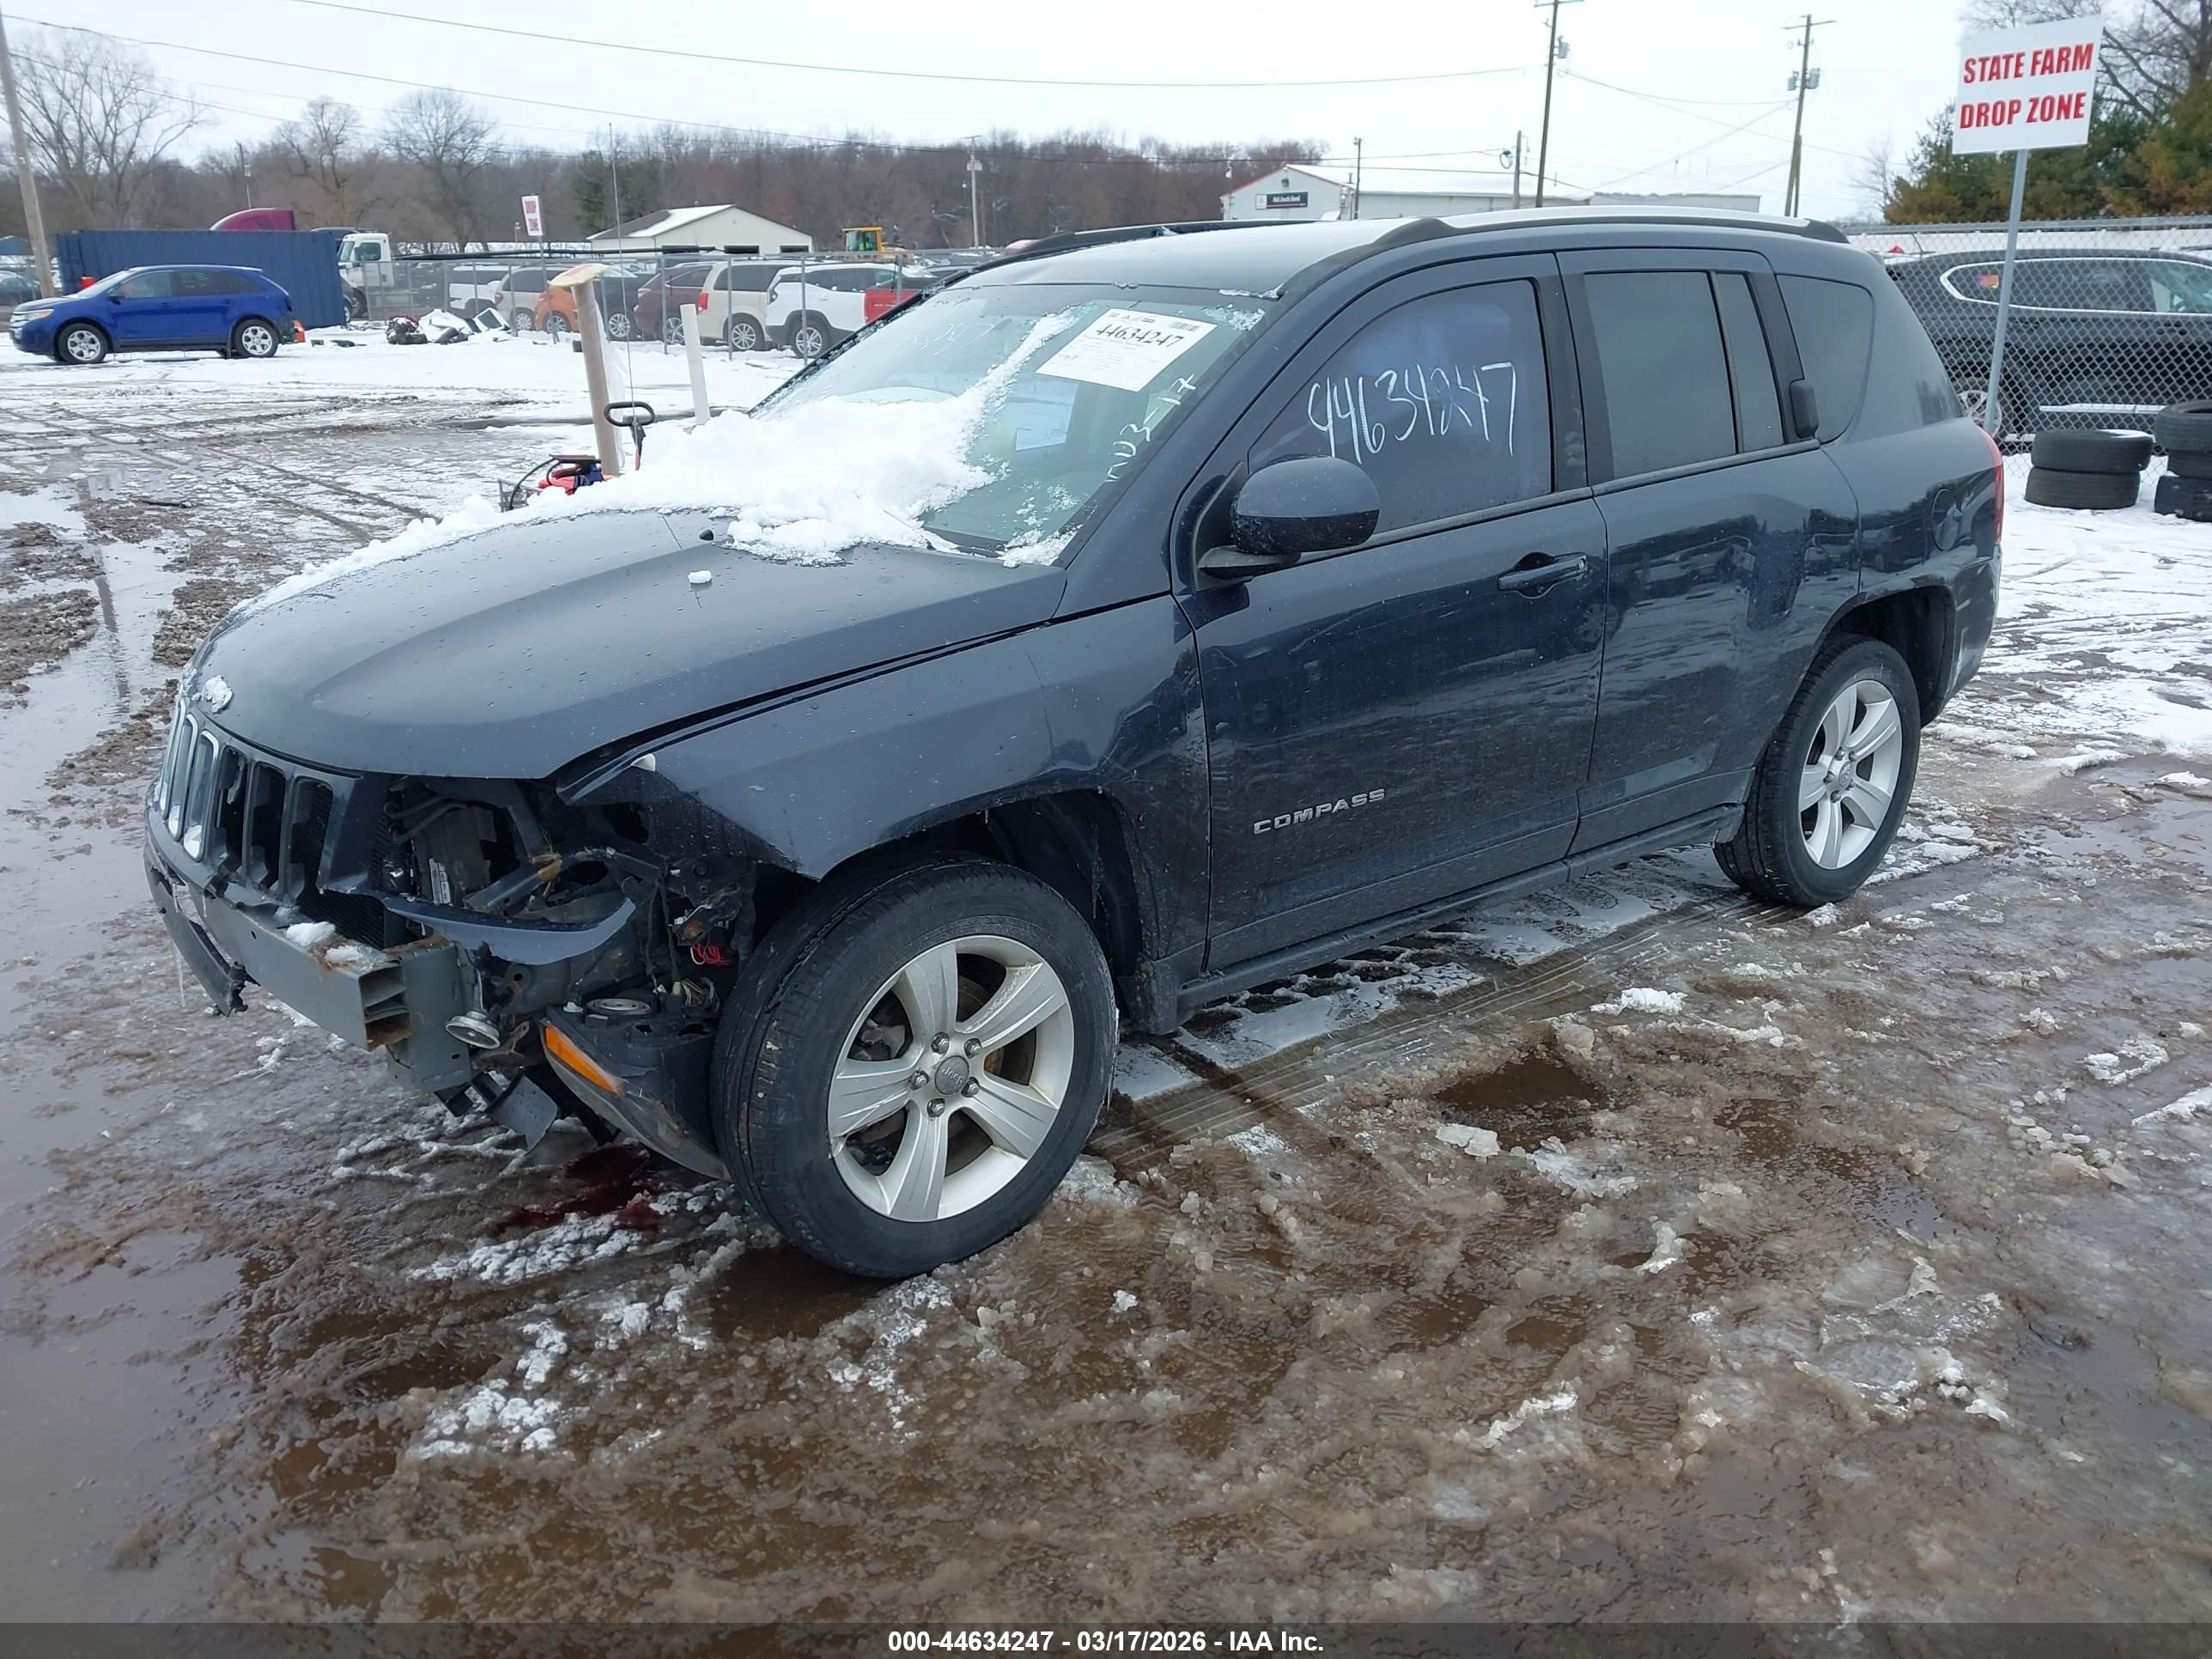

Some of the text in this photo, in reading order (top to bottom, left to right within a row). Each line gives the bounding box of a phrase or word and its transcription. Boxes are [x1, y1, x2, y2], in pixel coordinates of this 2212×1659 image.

[1963, 42, 2094, 84] STATE FARM
[1960, 92, 2087, 129] DROP ZONE
[1096, 323, 1186, 348] 44634247
[1253, 788, 1385, 835] COMPASS
